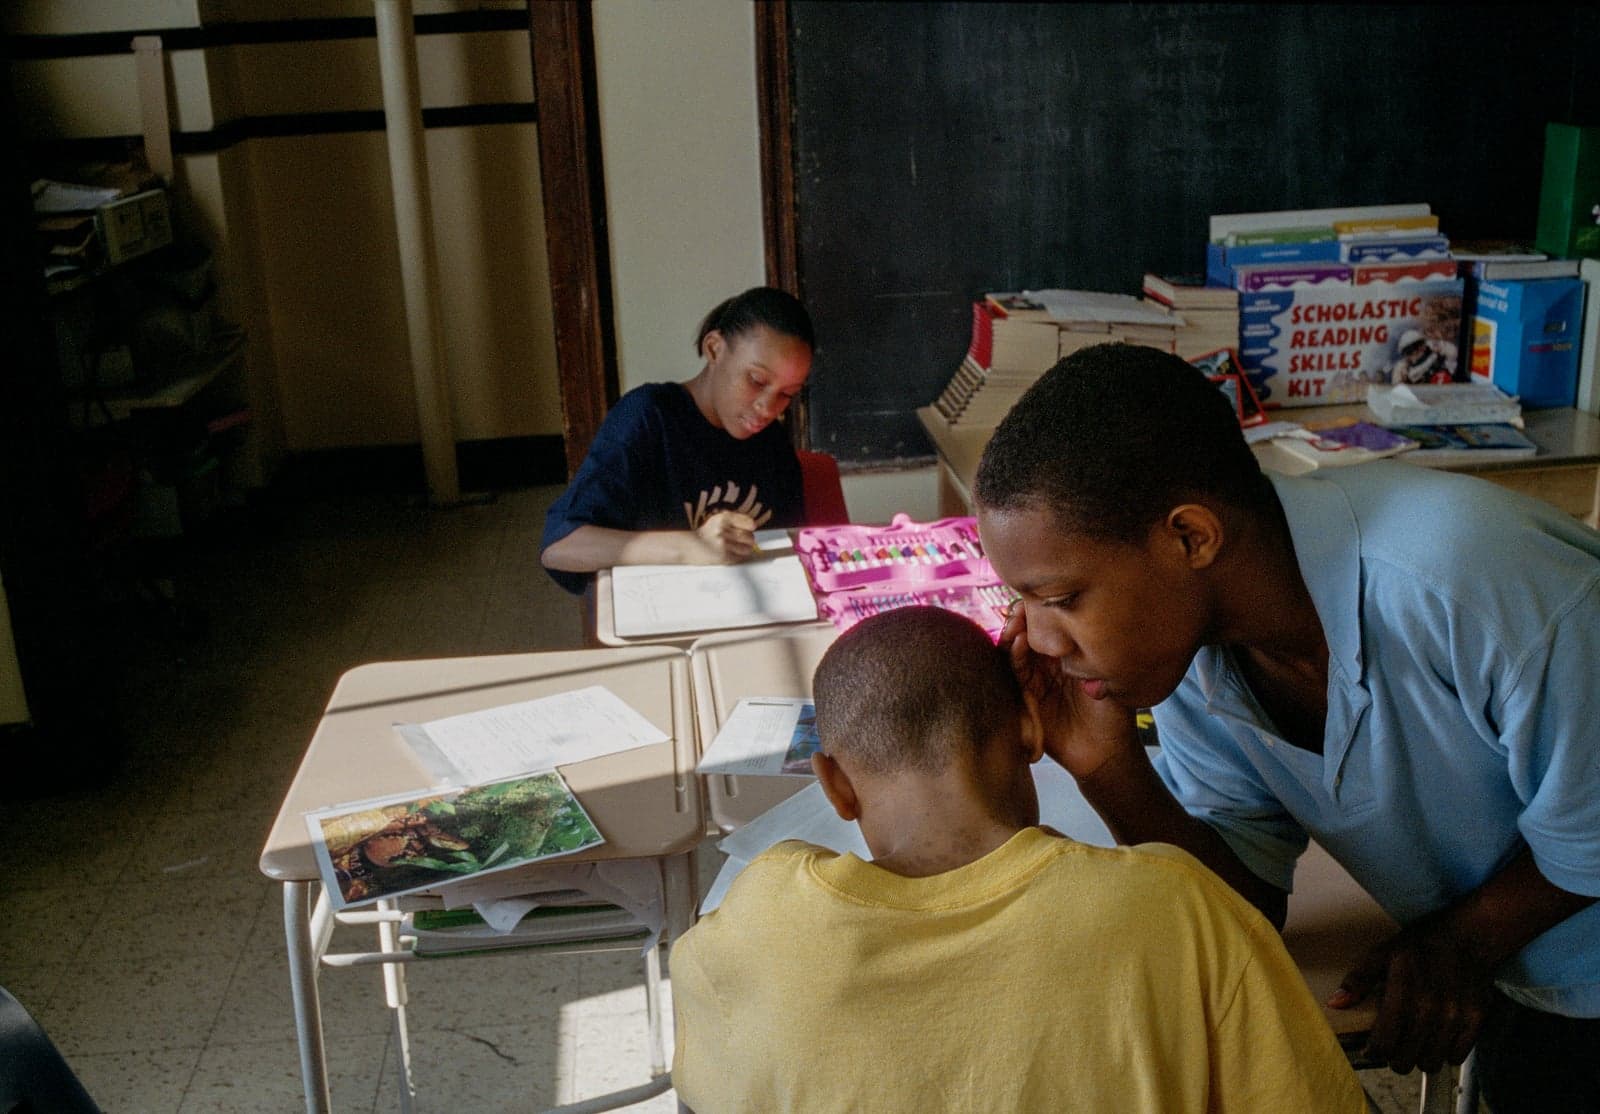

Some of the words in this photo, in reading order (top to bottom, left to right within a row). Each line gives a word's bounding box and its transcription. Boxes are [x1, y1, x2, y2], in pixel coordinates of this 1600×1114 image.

[1291, 297, 1422, 325] SCHOLASTIC
[1290, 325, 1389, 349] READING
[1288, 350, 1362, 374] SKILLS
[1288, 378, 1326, 398] KIT
